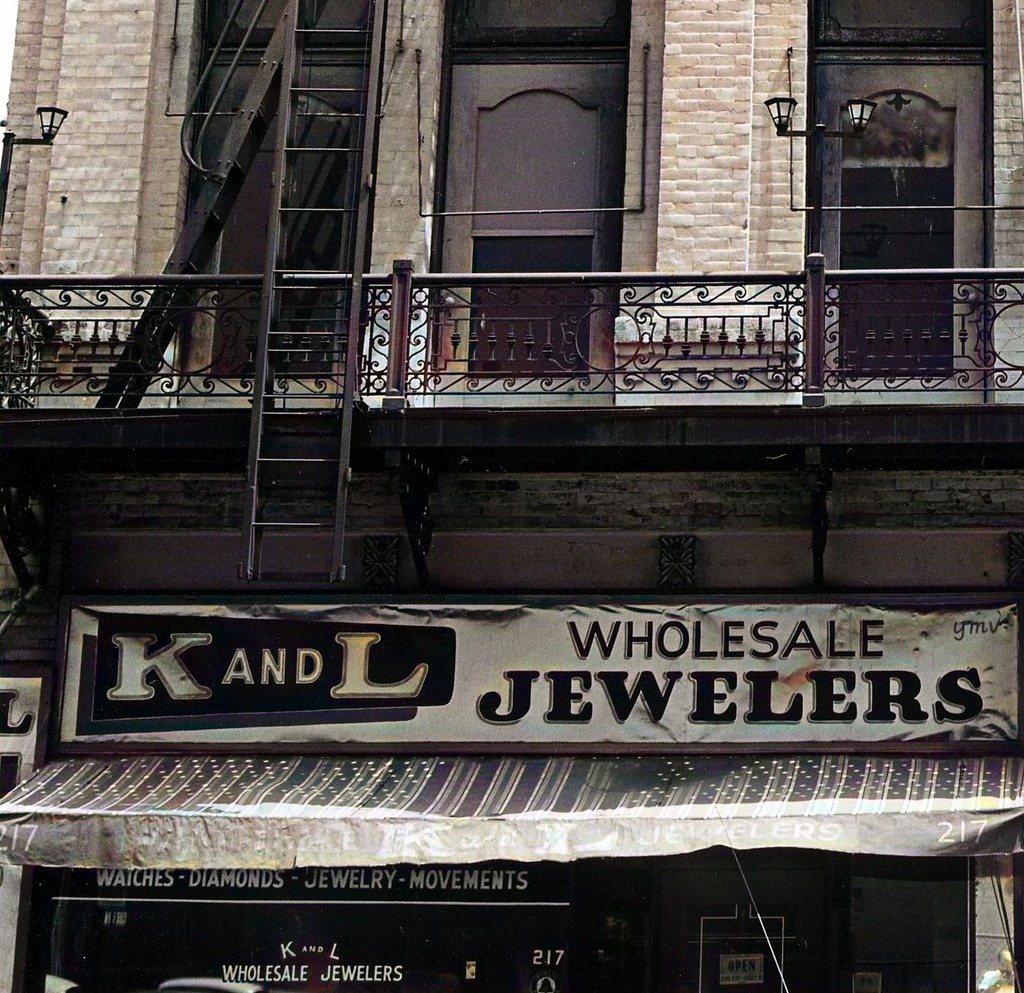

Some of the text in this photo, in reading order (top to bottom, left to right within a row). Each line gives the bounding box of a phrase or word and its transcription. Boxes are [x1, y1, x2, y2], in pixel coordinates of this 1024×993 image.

[566, 620, 885, 660] WHOLESALE
[106, 631, 429, 700] K AND L
[476, 667, 984, 726] JEWELERS
[937, 820, 989, 845] 217
[97, 868, 174, 888] WATCHES
[189, 868, 284, 889] DIAMONDS
[304, 869, 397, 889] JEWELRY
[409, 869, 529, 890] MOVEMENTS
[280, 941, 340, 960] K AND L
[532, 949, 565, 965] 217
[222, 965, 403, 982] WHOLESALE JEWELERS
[728, 959, 756, 973] OPEN
